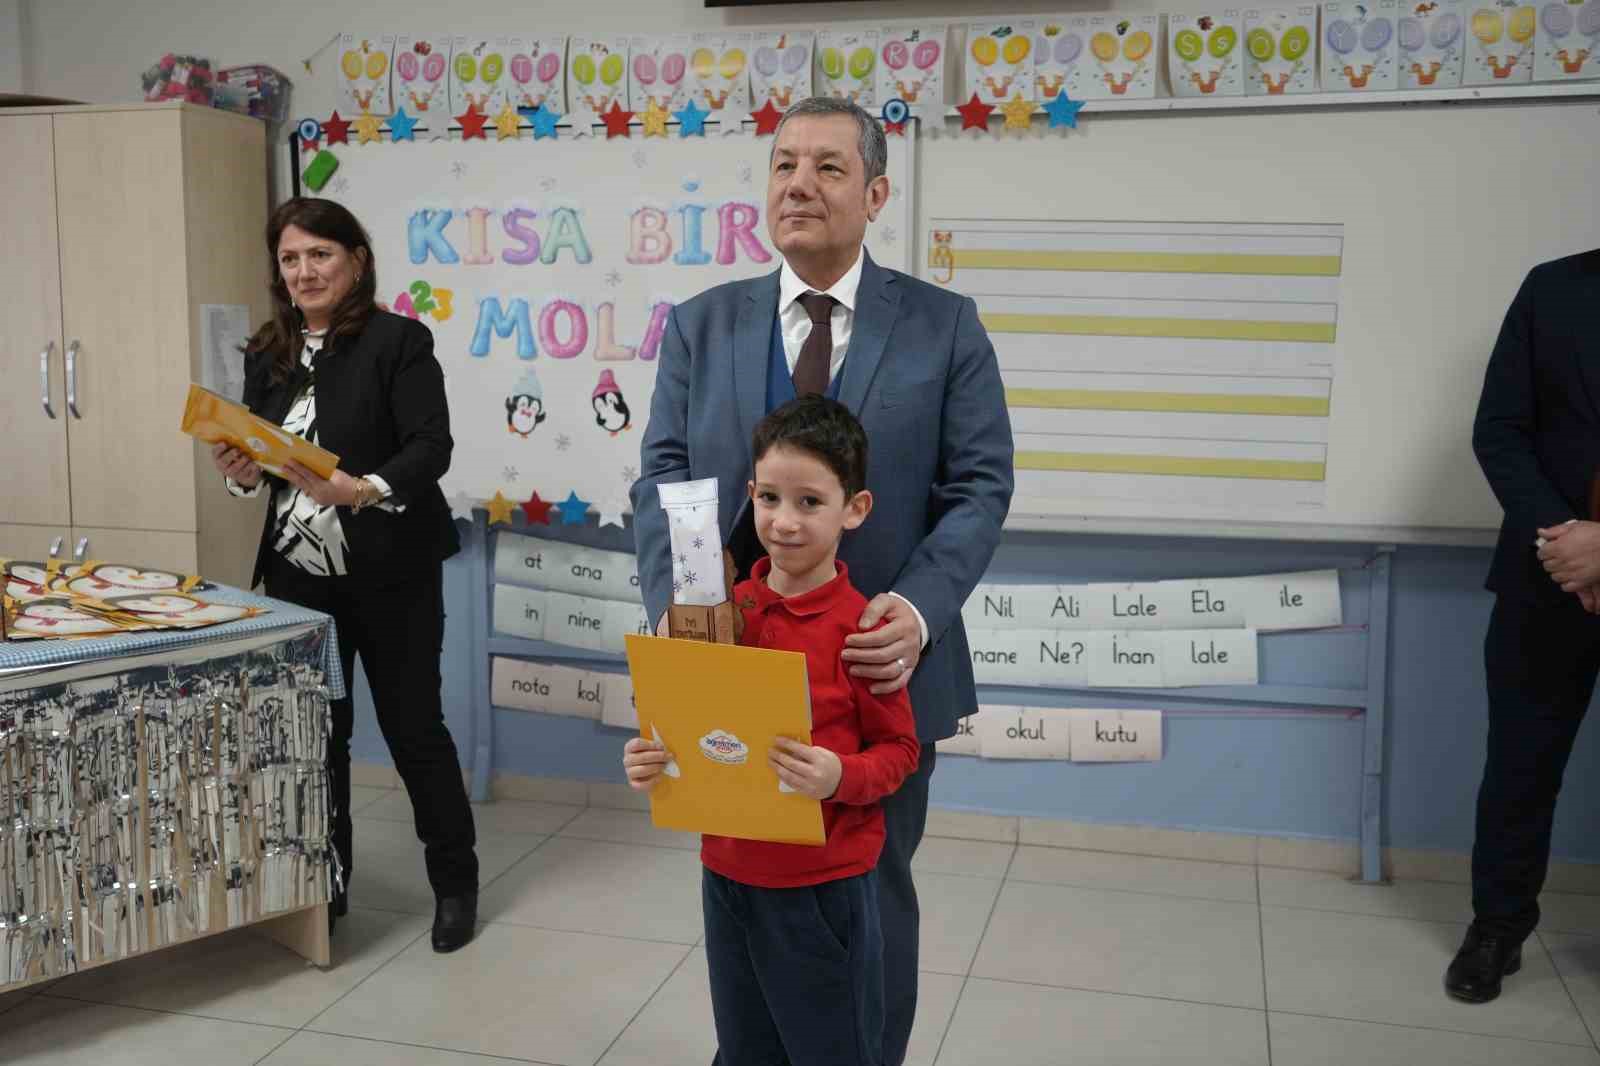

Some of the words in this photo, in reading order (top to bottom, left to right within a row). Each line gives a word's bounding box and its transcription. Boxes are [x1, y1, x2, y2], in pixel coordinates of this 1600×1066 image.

[407, 203, 593, 266] KISA
[624, 180, 773, 266] BİR
[525, 553, 543, 570] at
[571, 563, 603, 581] ana
[984, 595, 1014, 618] Nil
[1050, 594, 1081, 619] Ali
[1112, 593, 1158, 618] Lale
[1191, 589, 1226, 614] Ela
[1279, 583, 1304, 609] ile
[525, 603, 539, 621] in
[568, 612, 601, 631] nine
[972, 649, 1017, 665] nane
[1039, 642, 1084, 665] Ne?
[1112, 634, 1155, 665] İnan
[1190, 640, 1229, 665] lale
[511, 677, 550, 697] nota
[577, 679, 602, 704] kol
[1006, 717, 1047, 741] okul
[1095, 721, 1138, 744] kutu
